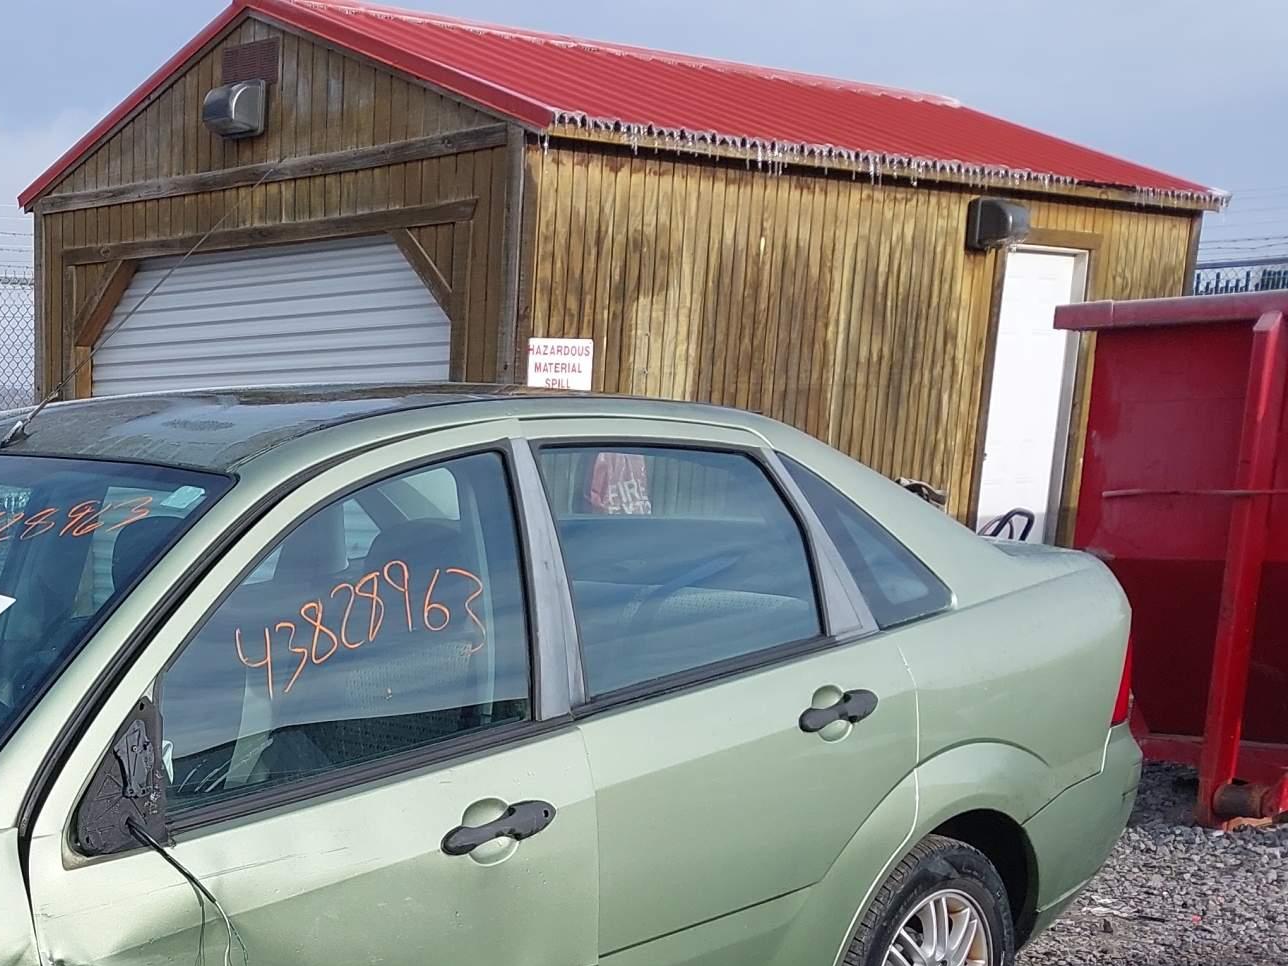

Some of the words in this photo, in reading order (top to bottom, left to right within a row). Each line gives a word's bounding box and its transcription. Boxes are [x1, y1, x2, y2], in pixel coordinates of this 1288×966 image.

[528, 344, 591, 357] HAZARDOUS
[534, 362, 582, 374] MATERIAL
[545, 377, 571, 389] SPILL
[235, 560, 487, 700] 43828963
